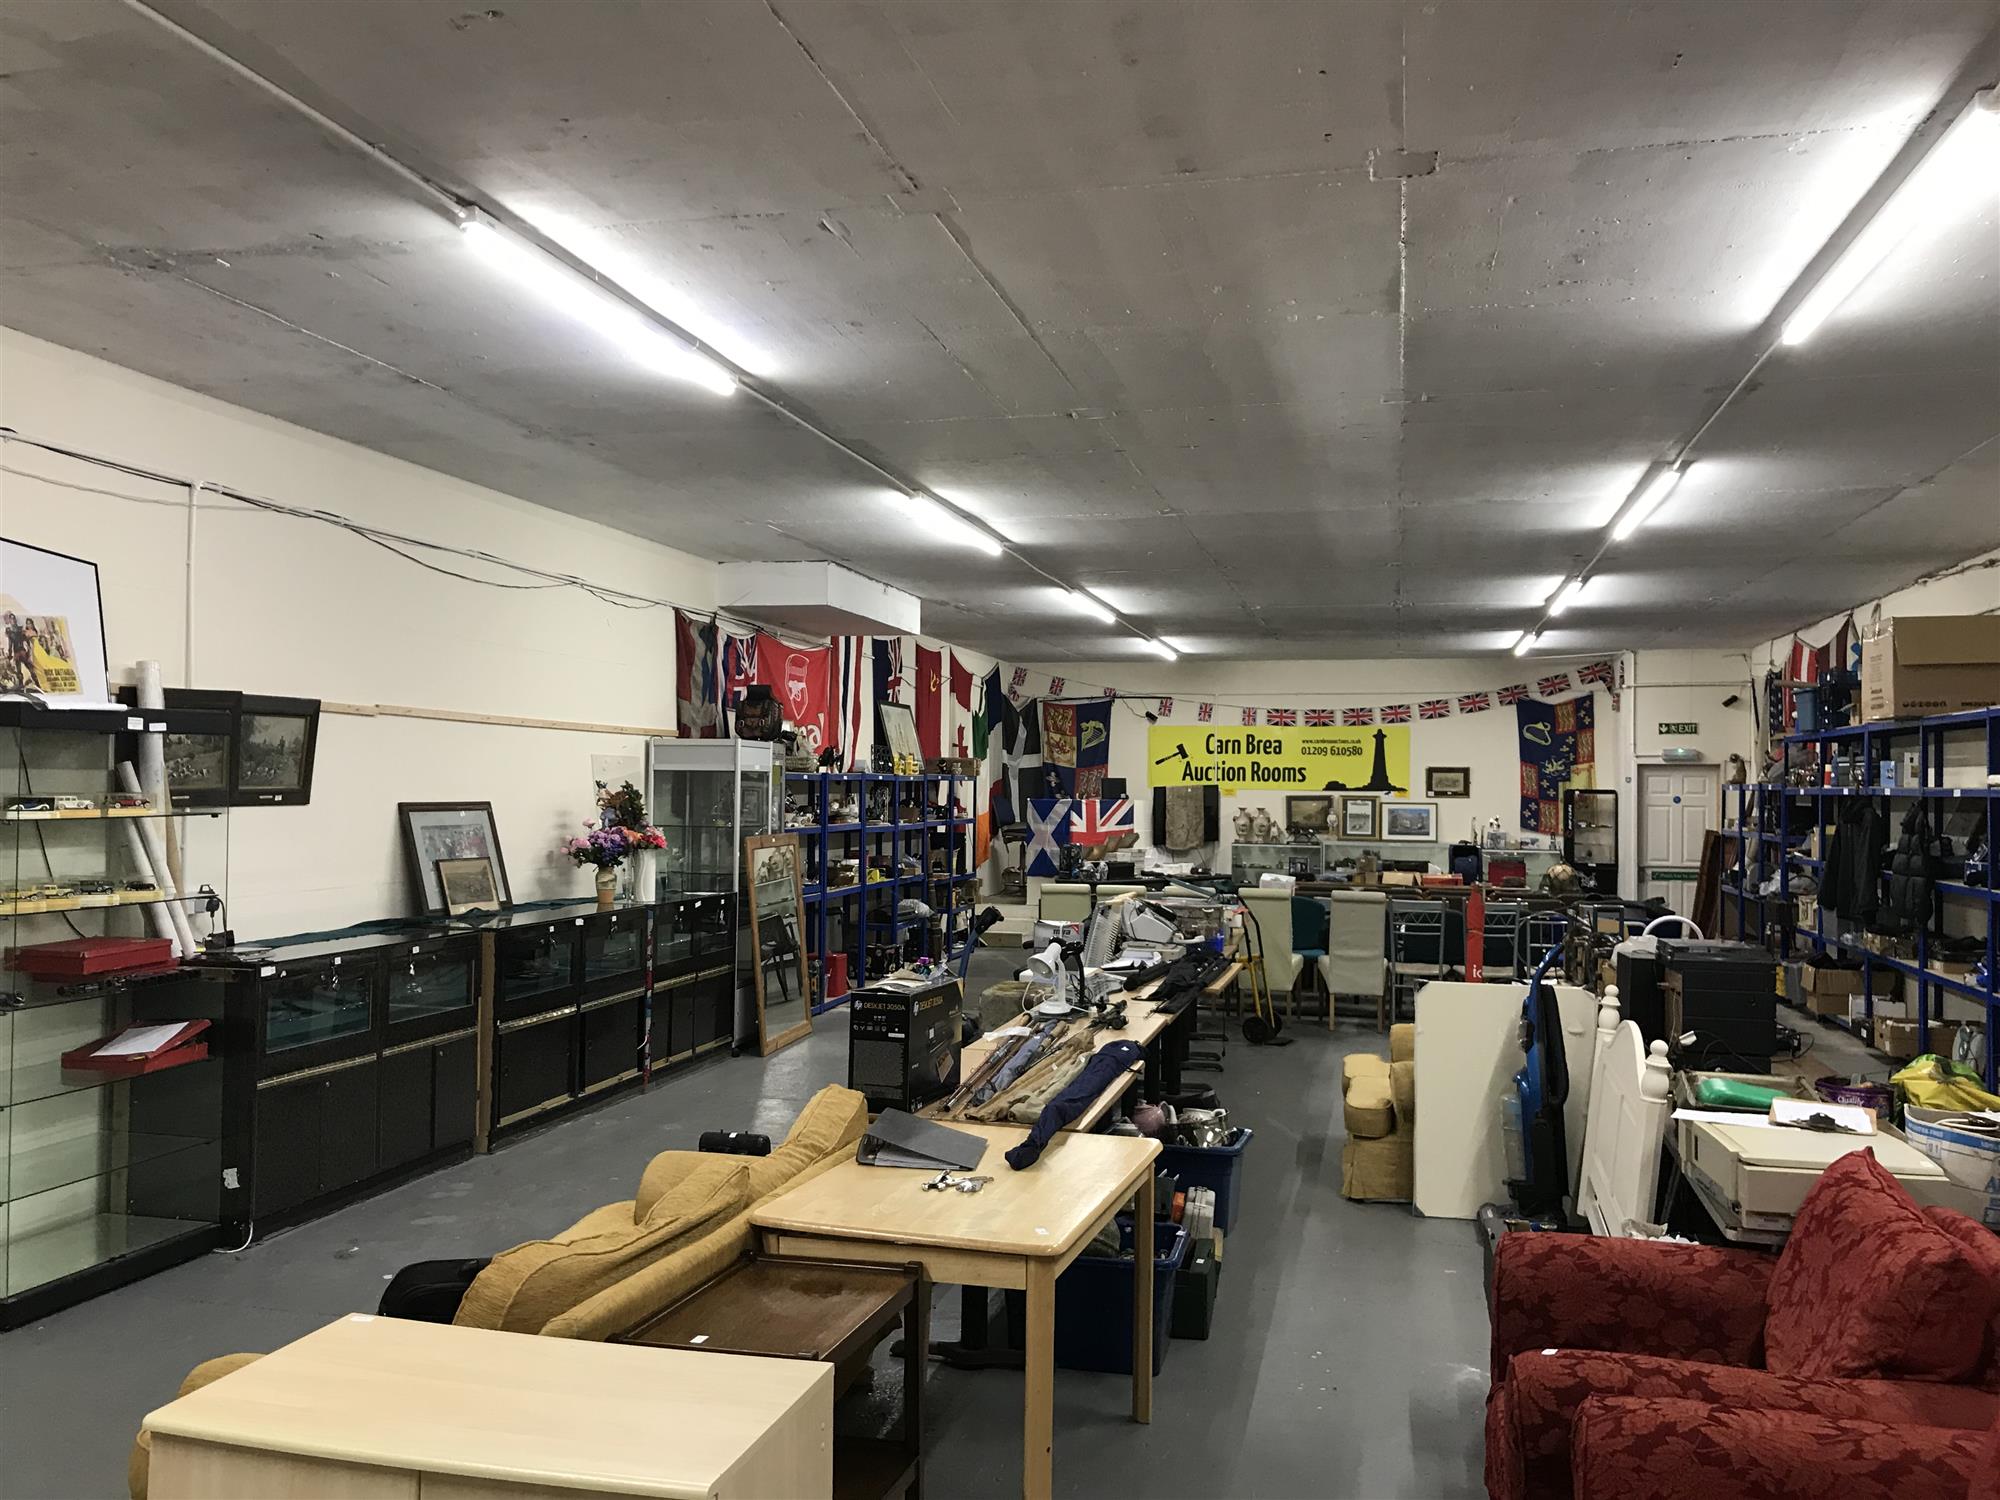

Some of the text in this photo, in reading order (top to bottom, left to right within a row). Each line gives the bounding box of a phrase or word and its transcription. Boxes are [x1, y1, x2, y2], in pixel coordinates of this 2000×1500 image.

[1679, 724, 1696, 733] EXIT
[1206, 734, 1282, 755] Carn Brea
[1301, 745, 1363, 757] 01209 610580
[1182, 761, 1307, 783] Auction Rooms
[863, 1002, 886, 1010] DESKJET
[1837, 1095, 1864, 1107] Quality
